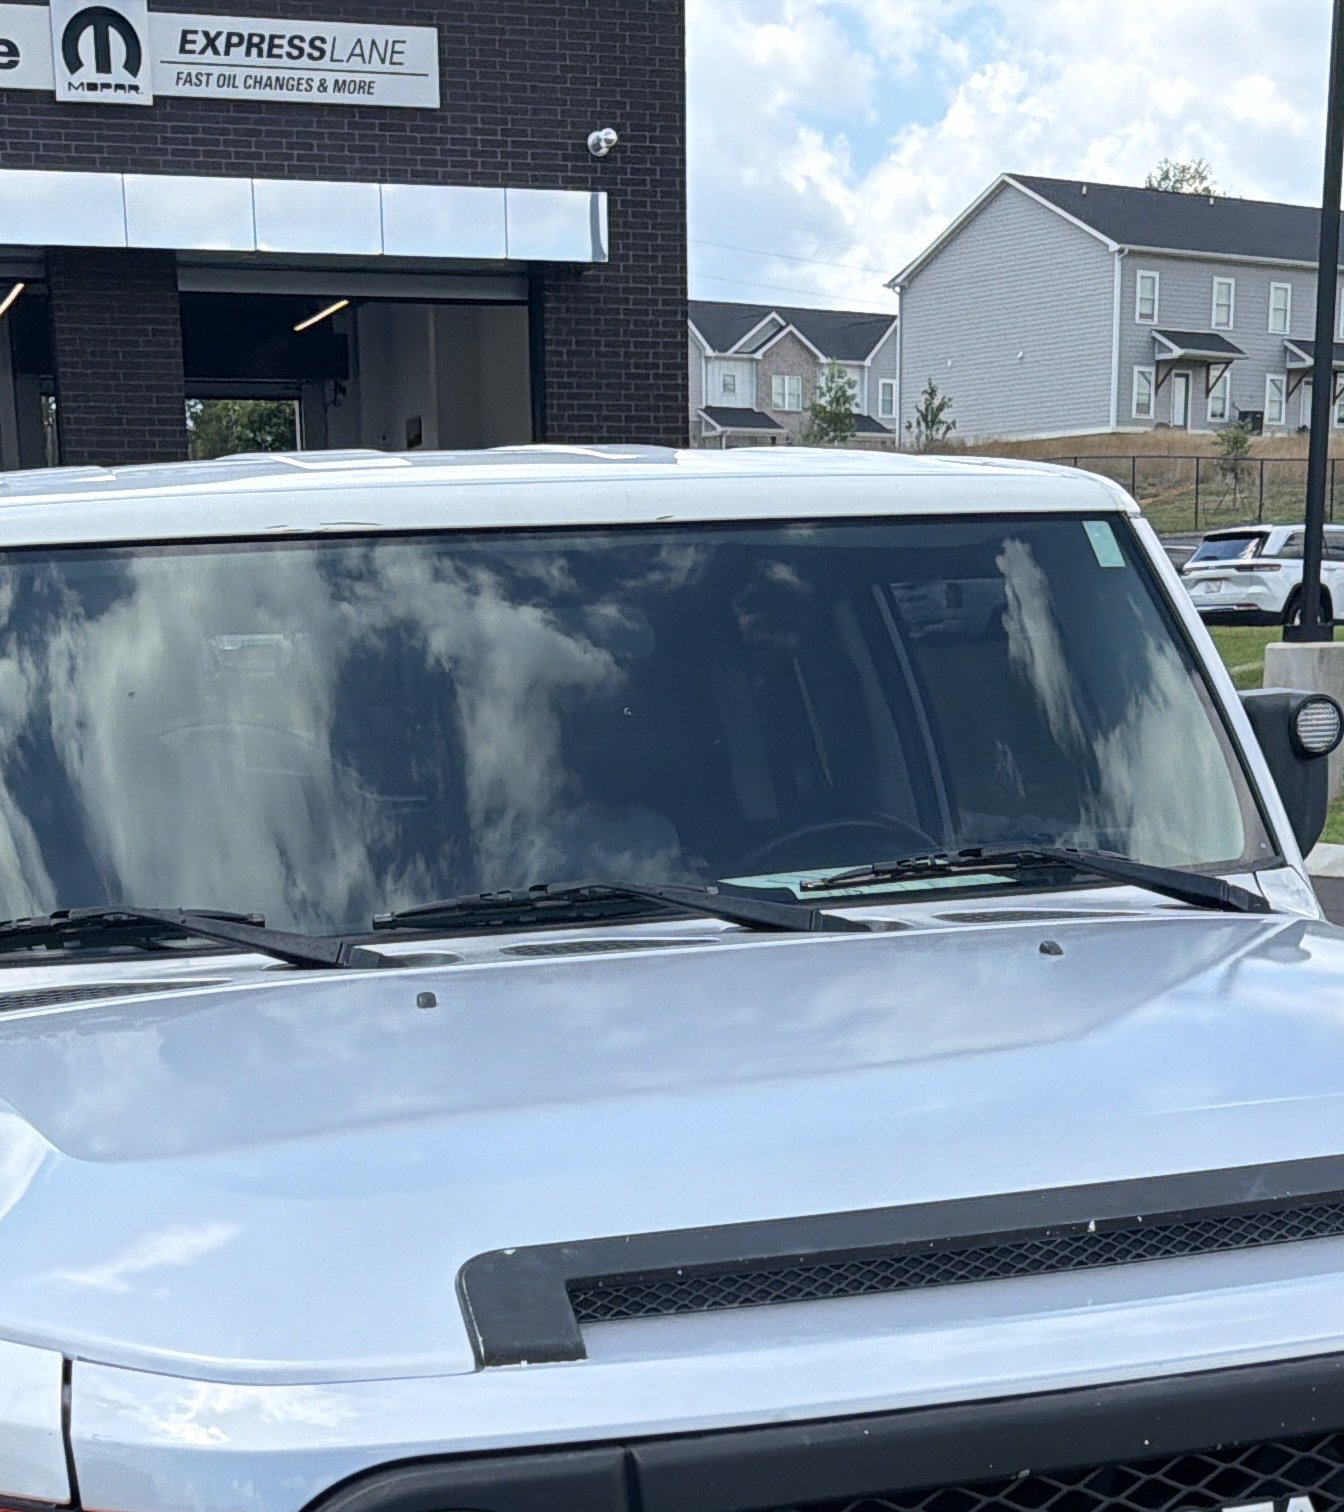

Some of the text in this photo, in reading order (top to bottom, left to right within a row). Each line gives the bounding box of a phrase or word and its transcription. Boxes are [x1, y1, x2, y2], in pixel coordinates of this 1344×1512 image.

[67, 81, 142, 95] MOPAR
[175, 71, 377, 96] FAST OIL CHANGES & MORE
